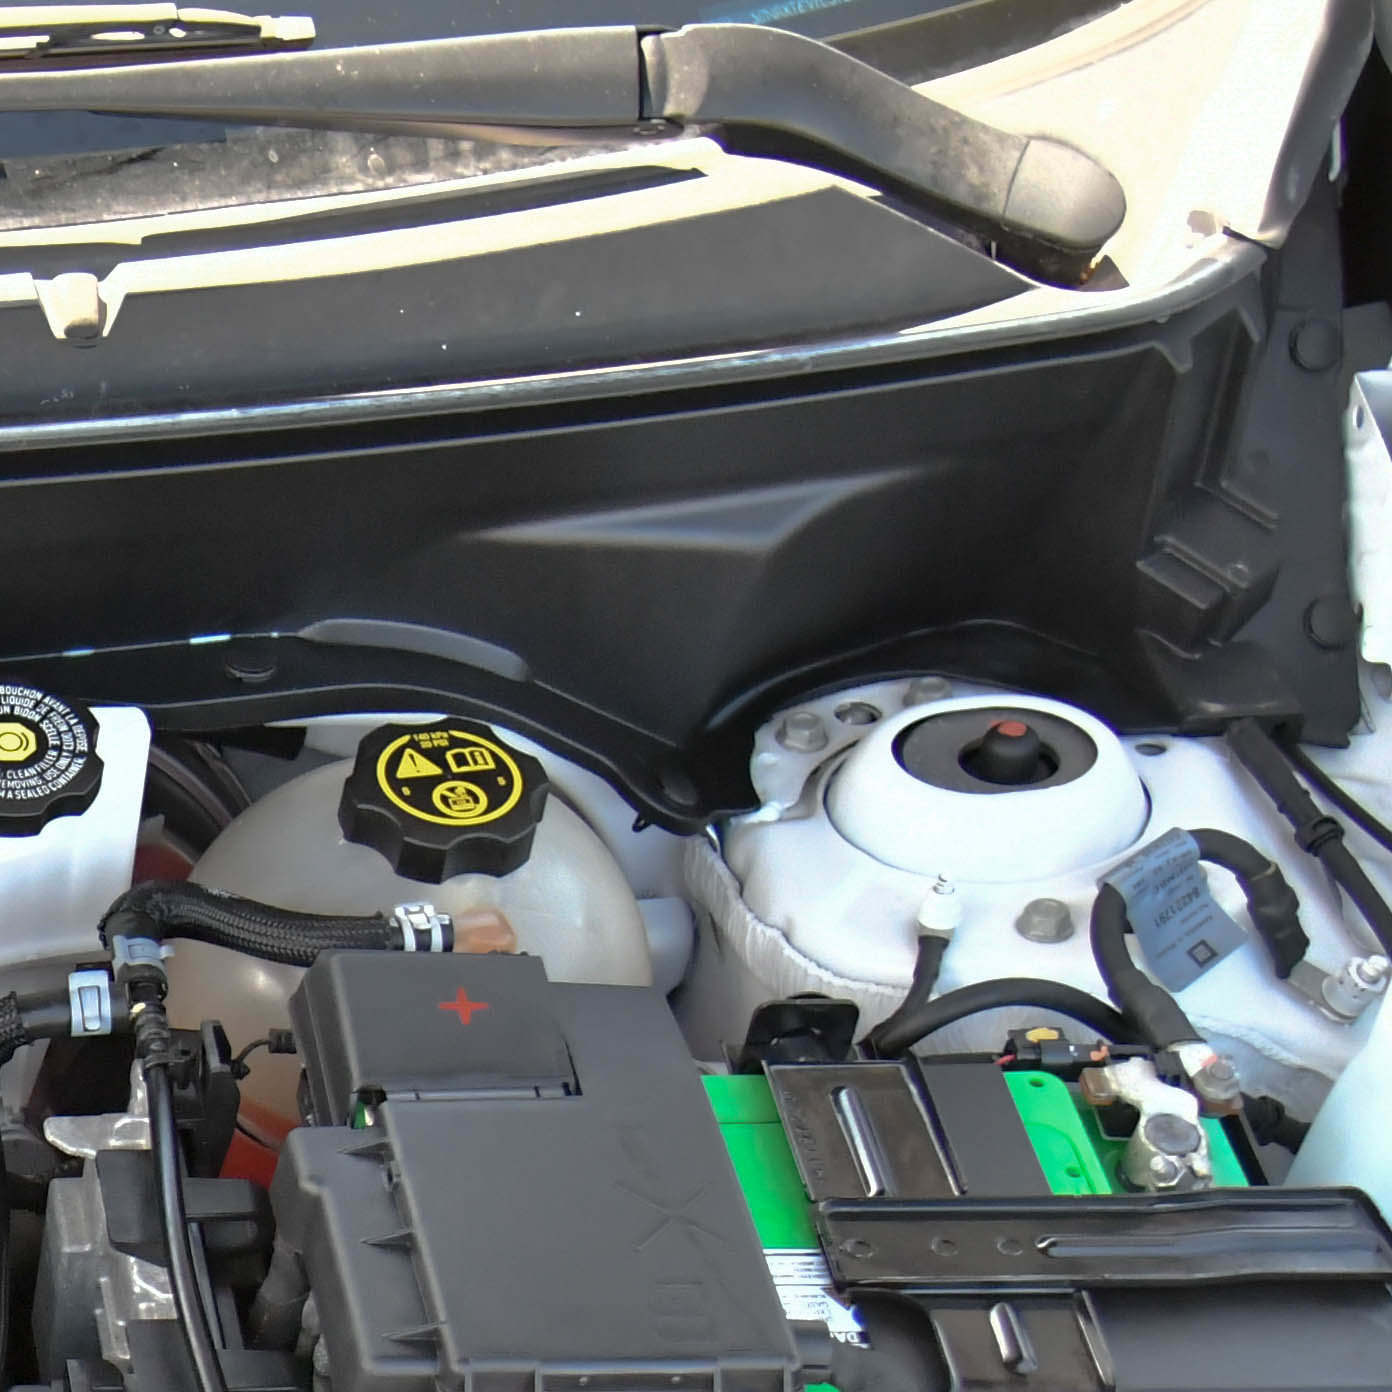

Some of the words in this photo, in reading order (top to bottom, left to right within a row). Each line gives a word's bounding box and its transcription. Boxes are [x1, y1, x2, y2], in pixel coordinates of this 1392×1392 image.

[1, 695, 36, 709] LIQUIDE
[36, 703, 50, 715] DE
[13, 706, 42, 722] BIDON
[42, 695, 71, 715] AVANT
[65, 714, 79, 725] LA
[6, 766, 37, 779] CLEAN
[34, 749, 59, 773] FILLER
[43, 767, 61, 780] USE
[7, 790, 14, 799] A
[15, 785, 50, 800] SEALED
